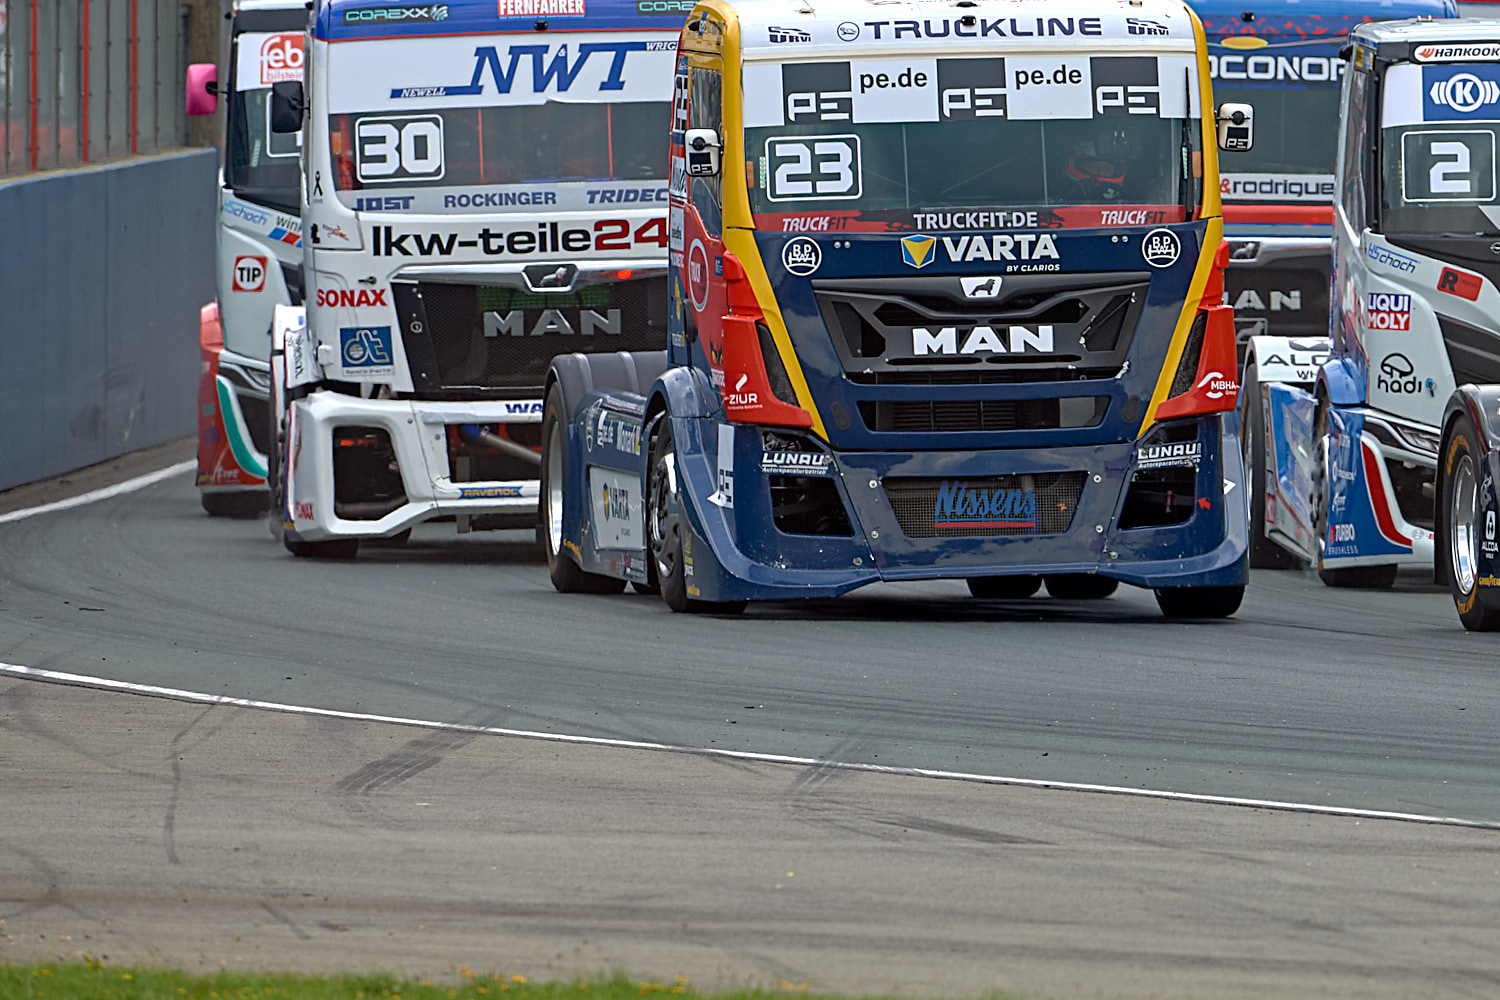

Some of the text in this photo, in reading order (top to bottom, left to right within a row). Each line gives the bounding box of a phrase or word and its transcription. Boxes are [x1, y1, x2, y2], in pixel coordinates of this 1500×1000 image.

[346, 7, 429, 21] COREXX
[638, 1, 698, 12] CORE
[864, 17, 1102, 40] TRUCKLINE
[471, 43, 640, 94] NWT
[1015, 64, 1082, 90] pe.de
[860, 68, 928, 94] pe.de
[401, 87, 446, 98] NEWELL
[942, 87, 1007, 118] PE
[1096, 85, 1160, 115] PE
[787, 90, 853, 121] PE
[358, 121, 441, 176] 30
[775, 141, 854, 195] 23
[1429, 142, 1471, 193] 2
[352, 195, 415, 212] JOST
[444, 191, 557, 209] ROCKINGER
[587, 188, 669, 204] TRIDEC
[782, 217, 848, 232] TRUCKFIT
[913, 211, 1038, 230] TRUCKFIT.DE
[1101, 210, 1167, 225] TRUCKFIT
[372, 217, 668, 257] lkw-teile24
[942, 233, 1060, 263] VARTA
[237, 267, 262, 282] TIP
[1006, 264, 1060, 273] BY CLARIOS
[1442, 270, 1459, 292] R
[317, 288, 388, 308] SONAX
[1368, 294, 1411, 313] LIQUI
[482, 308, 622, 338] MAN
[1367, 313, 1411, 331] MOLY
[912, 325, 1054, 356] MAN
[1377, 374, 1422, 394] hadi
[729, 392, 758, 405] ZIUR
[762, 452, 825, 466] LUNAU
[1137, 442, 1197, 460] LUNAU
[463, 487, 519, 498] RAVENOL
[934, 479, 1036, 517] Nissens
